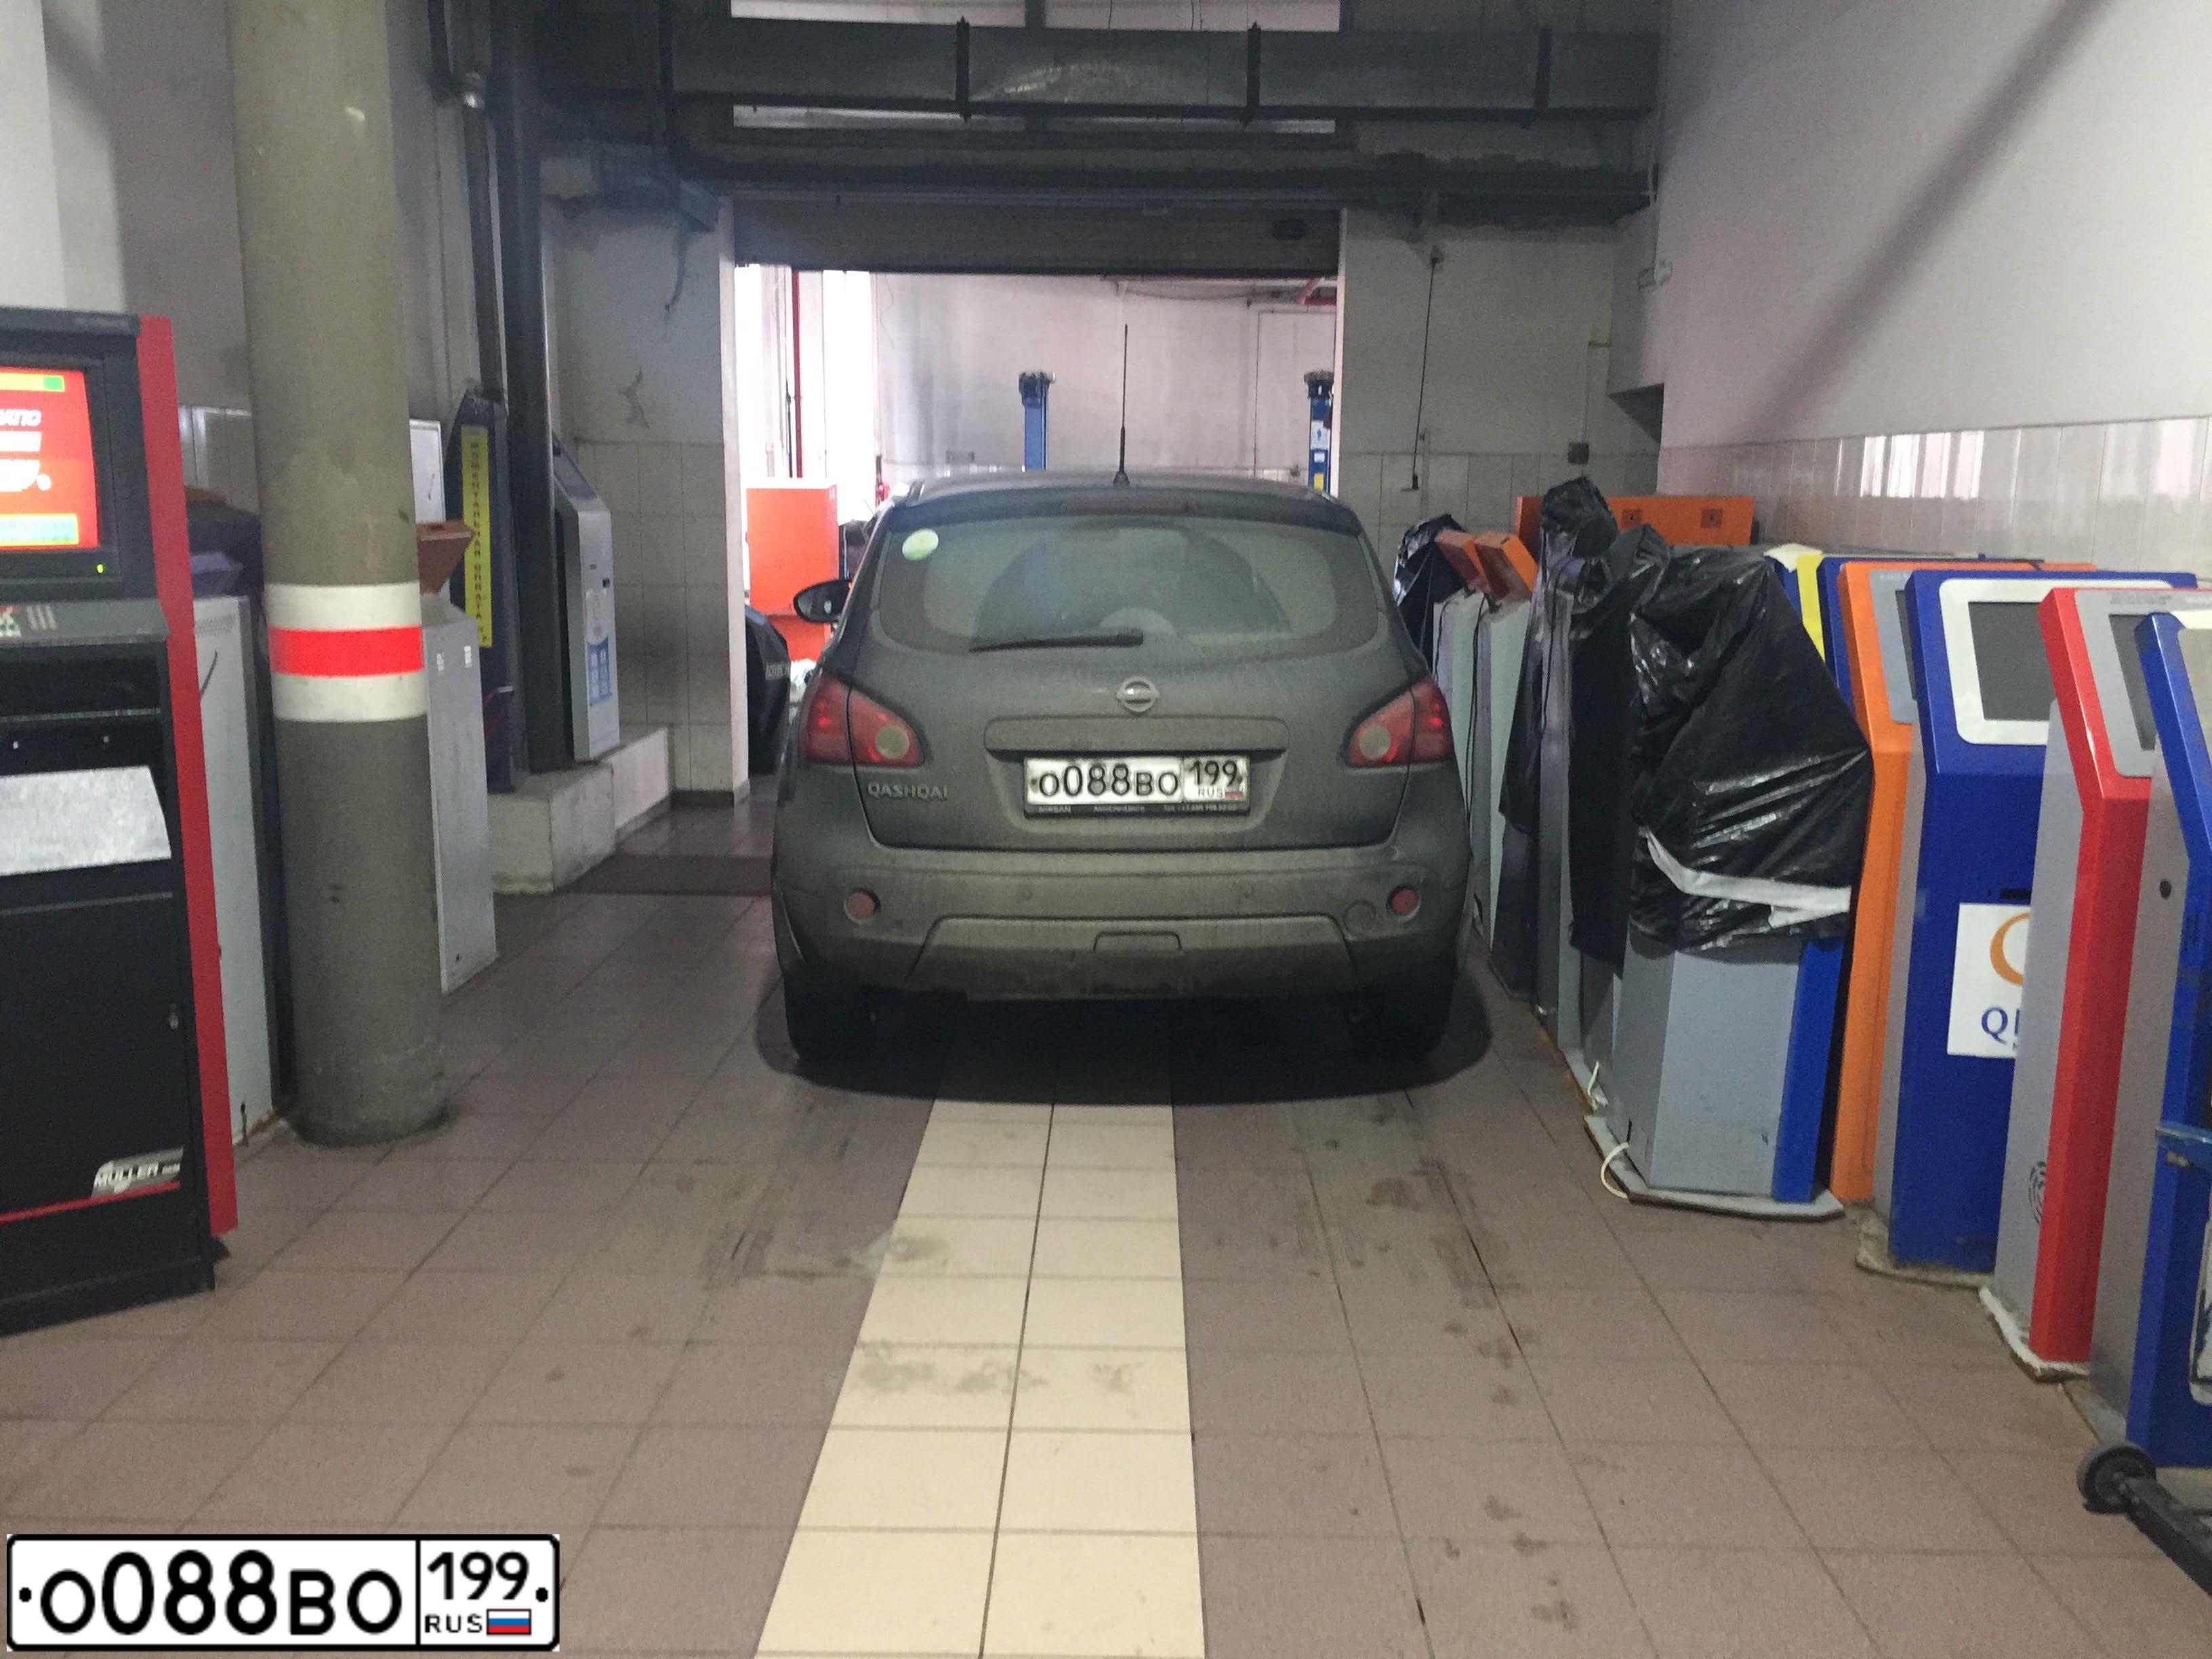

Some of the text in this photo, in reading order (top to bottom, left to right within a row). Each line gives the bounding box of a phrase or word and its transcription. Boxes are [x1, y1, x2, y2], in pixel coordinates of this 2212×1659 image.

[1189, 760, 1238, 787] 199
[867, 782, 948, 800] QASHQAI
[1198, 787, 1225, 798] RUS
